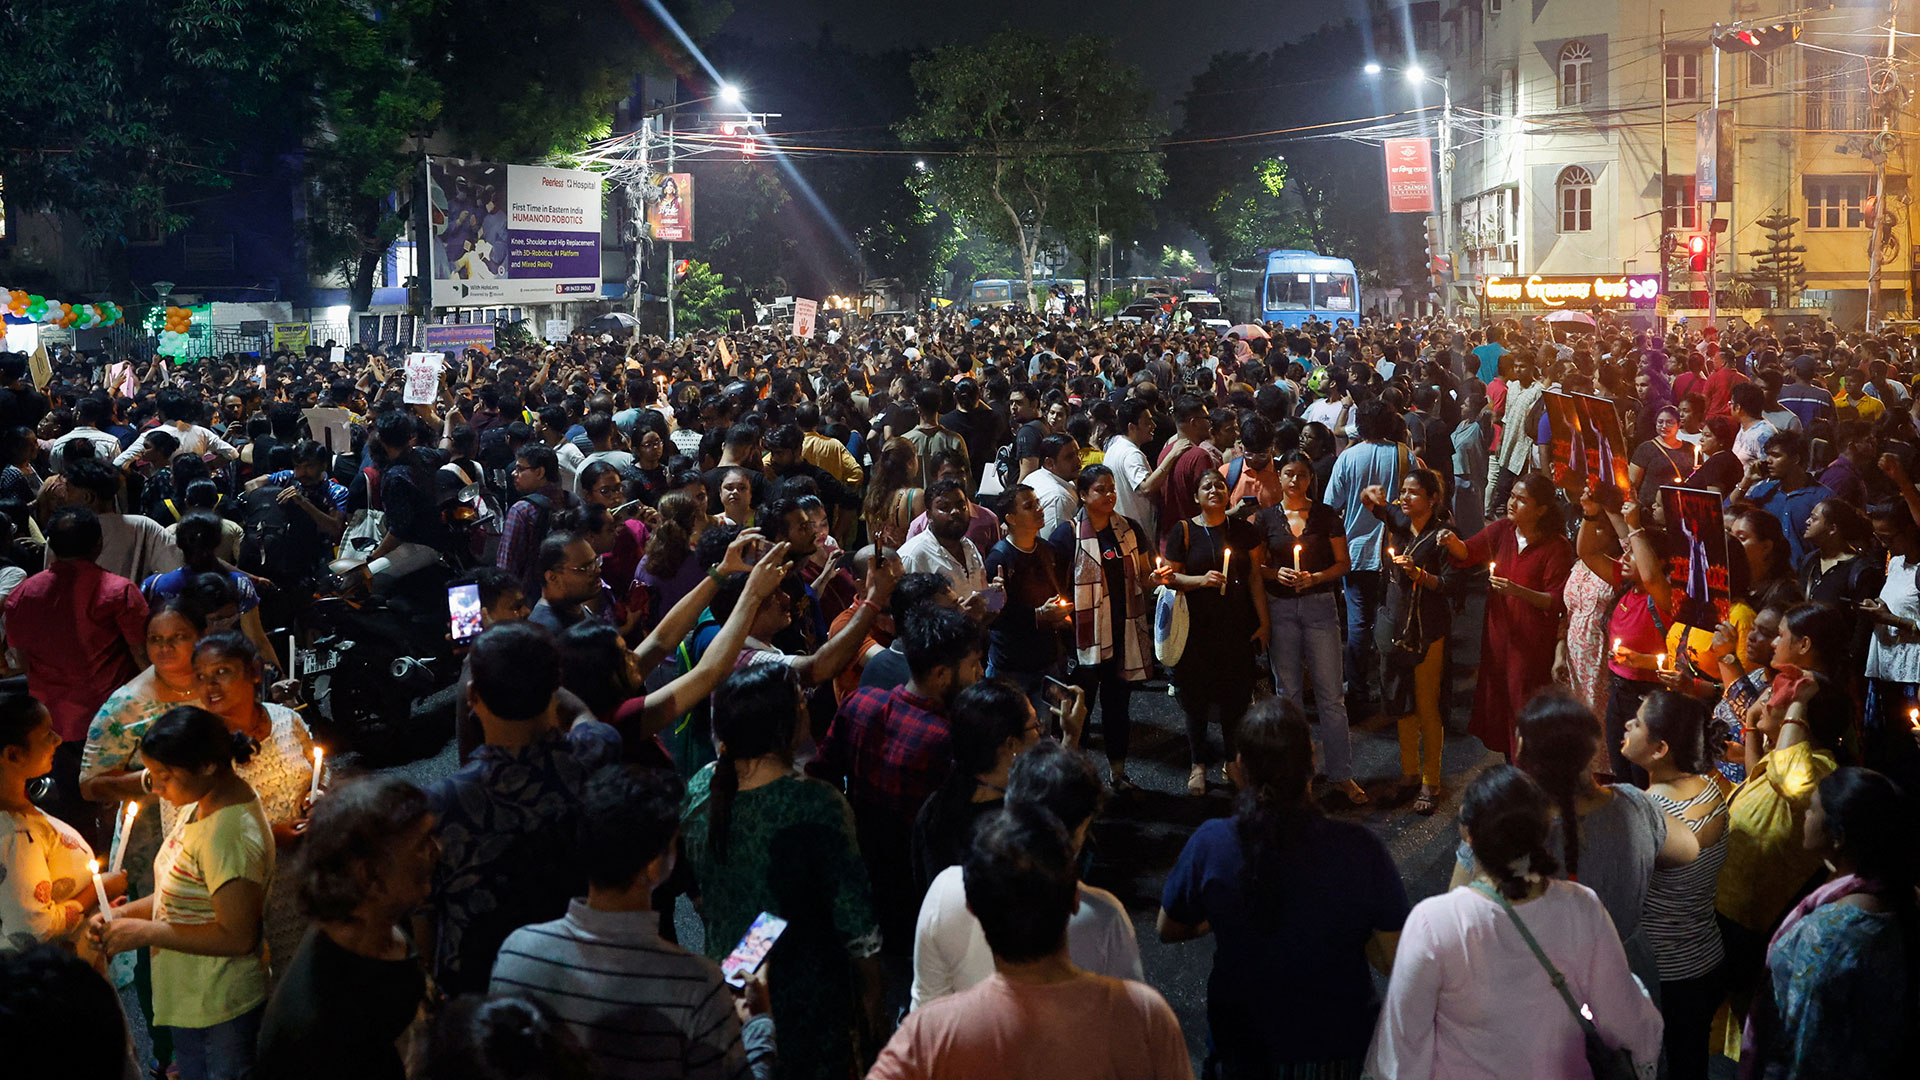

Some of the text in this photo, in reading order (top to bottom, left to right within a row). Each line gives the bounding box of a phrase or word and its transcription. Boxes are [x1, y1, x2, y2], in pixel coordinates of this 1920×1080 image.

[542, 176, 596, 191] Peerless Hospital
[512, 203, 583, 215] First Time in Eastern India
[512, 213, 583, 225] HUMANOID ROBOTICS
[511, 238, 525, 246] Knee,
[526, 238, 548, 246] Shoulder
[557, 239, 566, 247] Hip
[566, 239, 595, 247] Replacement
[537, 261, 553, 269] Reality
